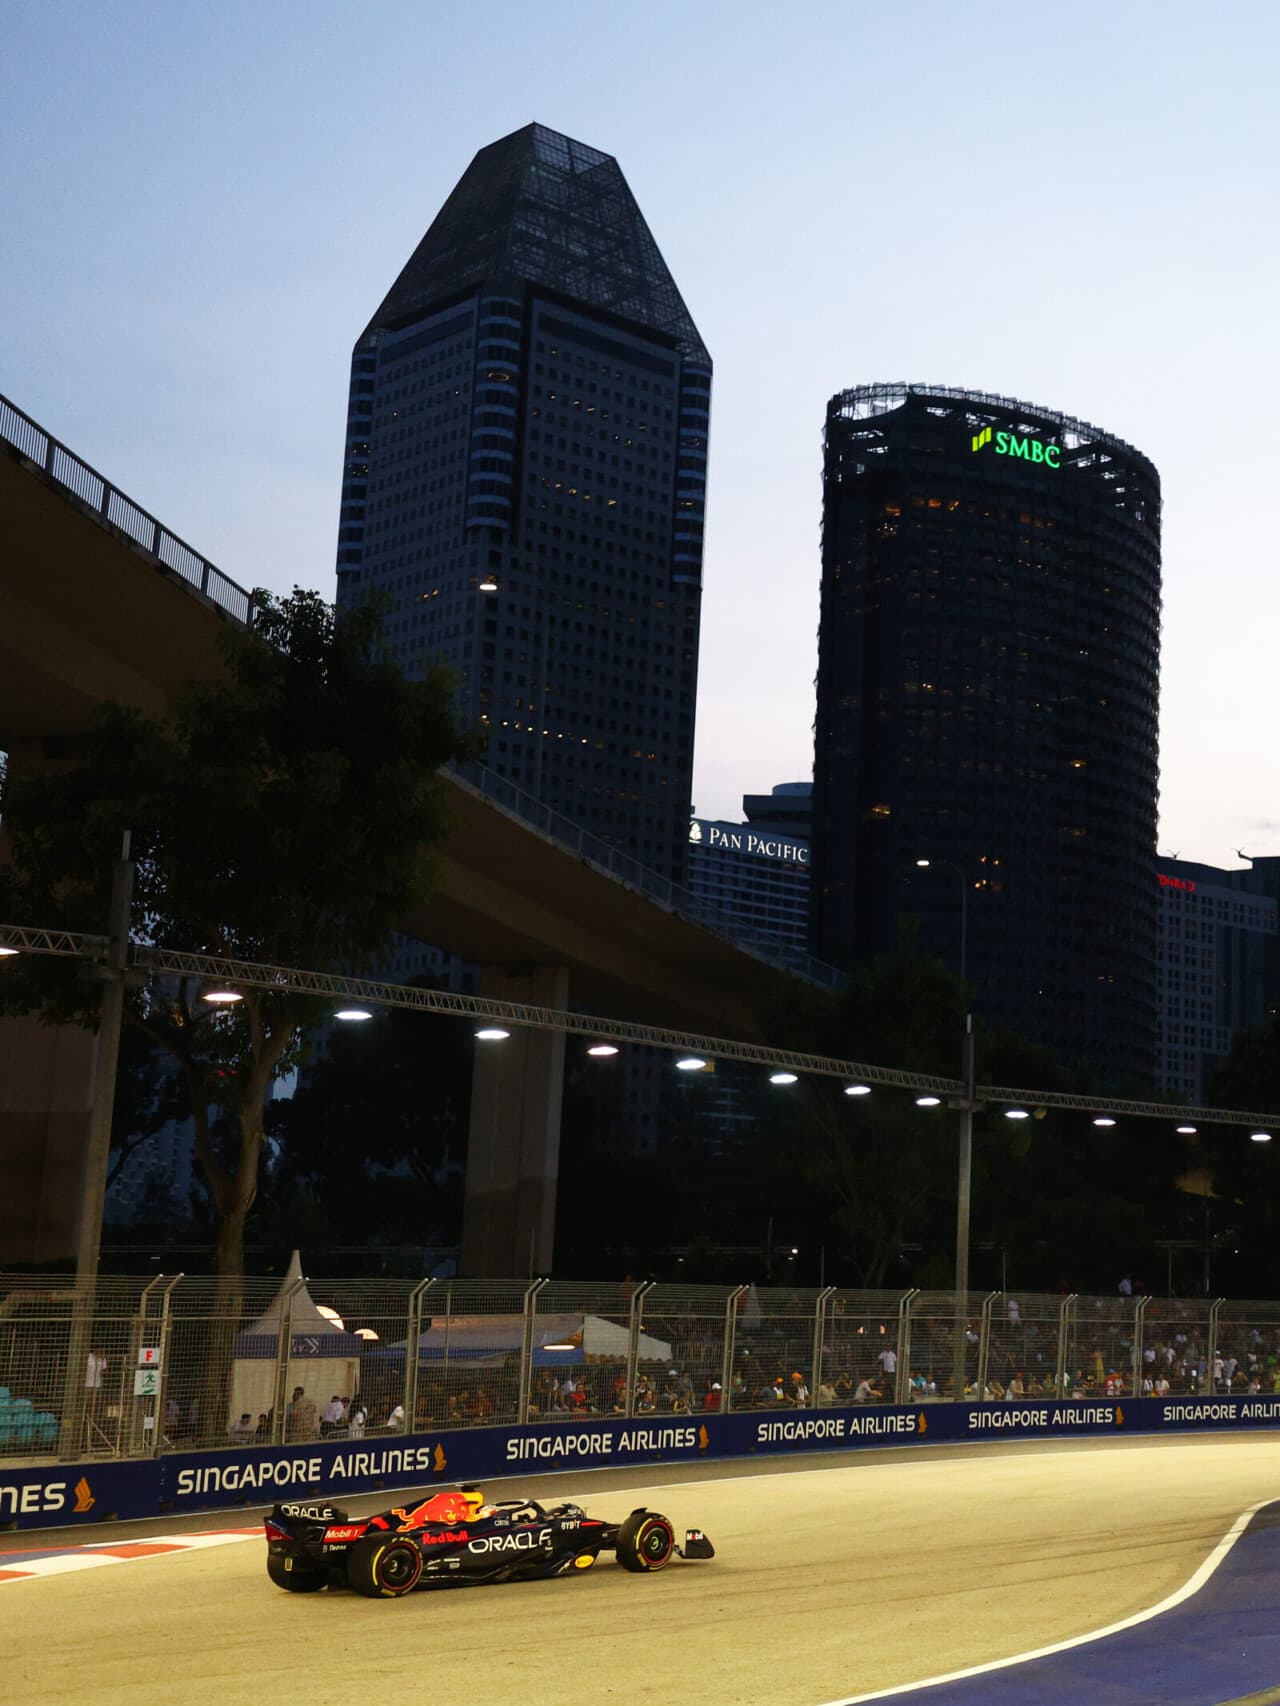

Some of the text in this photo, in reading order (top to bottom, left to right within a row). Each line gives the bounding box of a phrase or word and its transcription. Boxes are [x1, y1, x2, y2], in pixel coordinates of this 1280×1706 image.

[995, 431, 1060, 469] SMBC
[709, 827, 809, 862] PAN PACIFIC
[968, 1407, 1113, 1429] SINGAPORE AIRLINES
[1163, 1404, 1237, 1421] SINGAPORE
[757, 1414, 916, 1442] SINGAPORE AIRLINES
[506, 1427, 696, 1461] SINGAPORE AIRLINES
[177, 1447, 430, 1495] SINGAPORE AIRLINES
[281, 1504, 336, 1521] ORACLE
[325, 1529, 352, 1539] Mobil
[422, 1532, 445, 1545] Red
[446, 1530, 469, 1542] Bull
[468, 1528, 553, 1554] ORACLE
